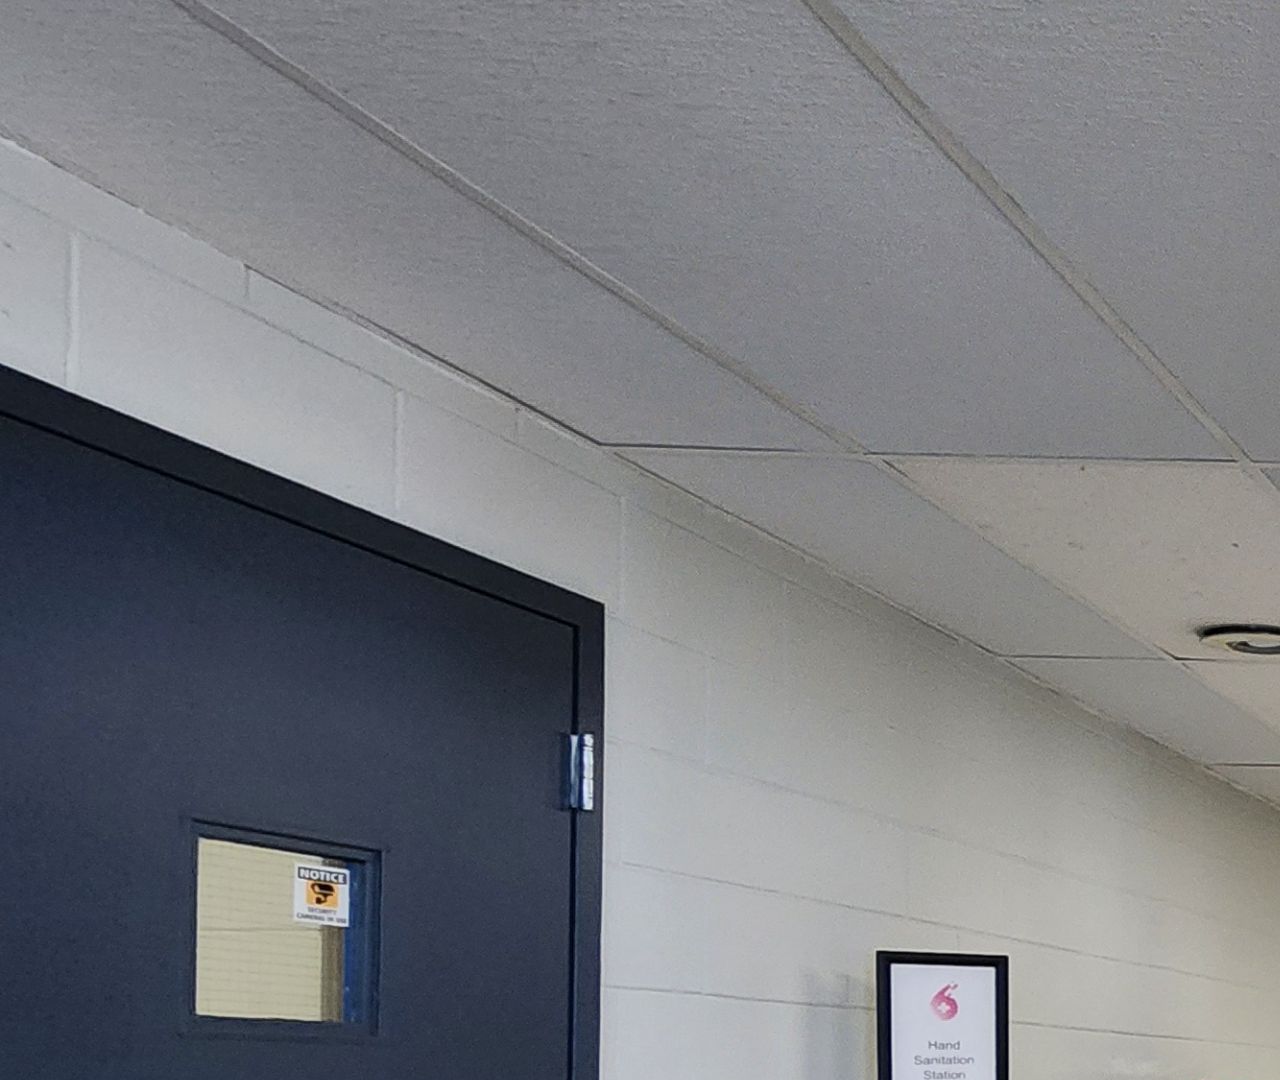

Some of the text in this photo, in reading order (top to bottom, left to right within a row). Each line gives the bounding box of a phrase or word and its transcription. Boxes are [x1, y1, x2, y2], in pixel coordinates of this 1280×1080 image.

[299, 868, 345, 883] NOTICE
[928, 1041, 961, 1051] Hand
[914, 1055, 975, 1066] Sanitation
[923, 1070, 966, 1080] Station
